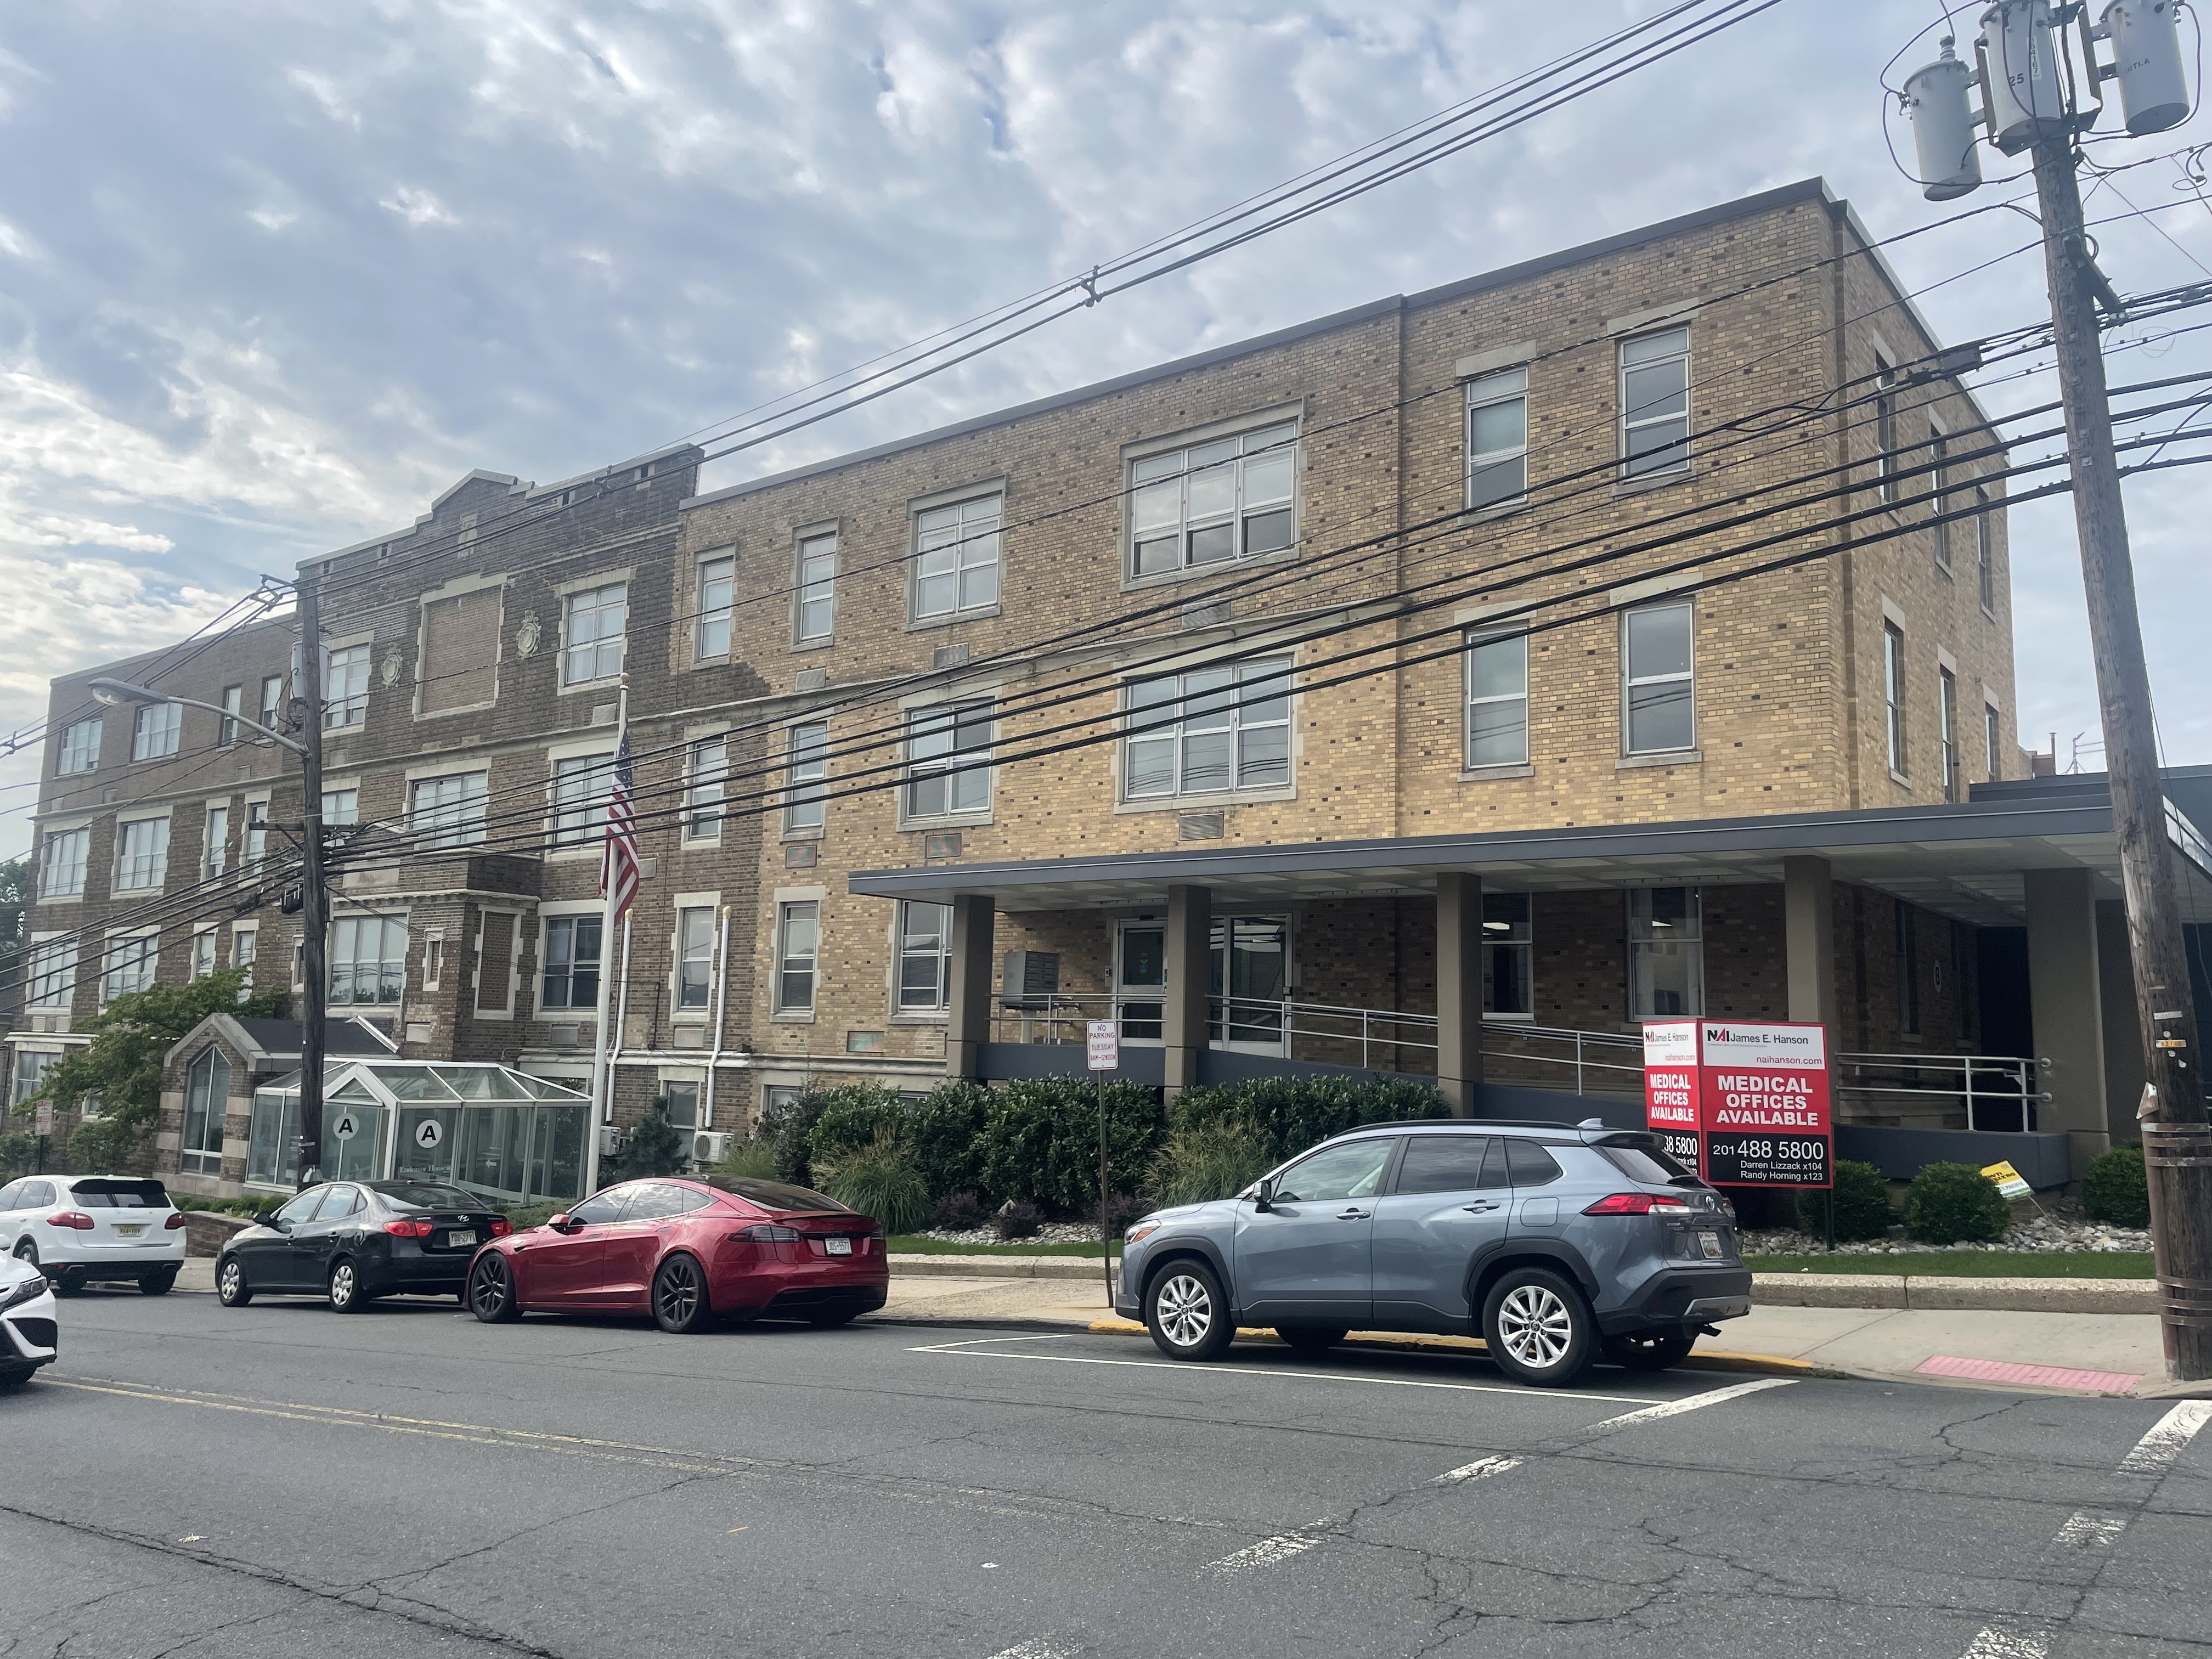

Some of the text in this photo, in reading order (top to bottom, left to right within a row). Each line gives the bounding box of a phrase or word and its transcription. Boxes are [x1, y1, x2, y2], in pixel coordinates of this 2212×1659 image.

[2008, 72, 2024, 87] 25
[1672, 1032, 1689, 1041] Hanson
[1707, 1028, 1808, 1044] NAI James E. Hanson
[1756, 1056, 1822, 1065] naihanson.com
[1650, 1074, 1691, 1090] MEDICAL
[1718, 1075, 1813, 1093] MEDICAL
[1653, 1091, 1689, 1106] OFFICES
[1726, 1093, 1807, 1110] OFFICES
[1651, 1106, 1695, 1122] AVAILABLE
[1716, 1109, 1819, 1126] AVAILABLE
[338, 1119, 353, 1133] A
[421, 1126, 436, 1141] A
[1675, 1136, 1697, 1155] 5800
[1713, 1139, 1824, 1160] 201 488 5800
[1740, 1160, 1768, 1169] Darren
[1771, 1161, 1801, 1170] Lizzack
[1741, 1170, 1767, 1181] Randy
[1769, 1172, 1801, 1182] Horning
